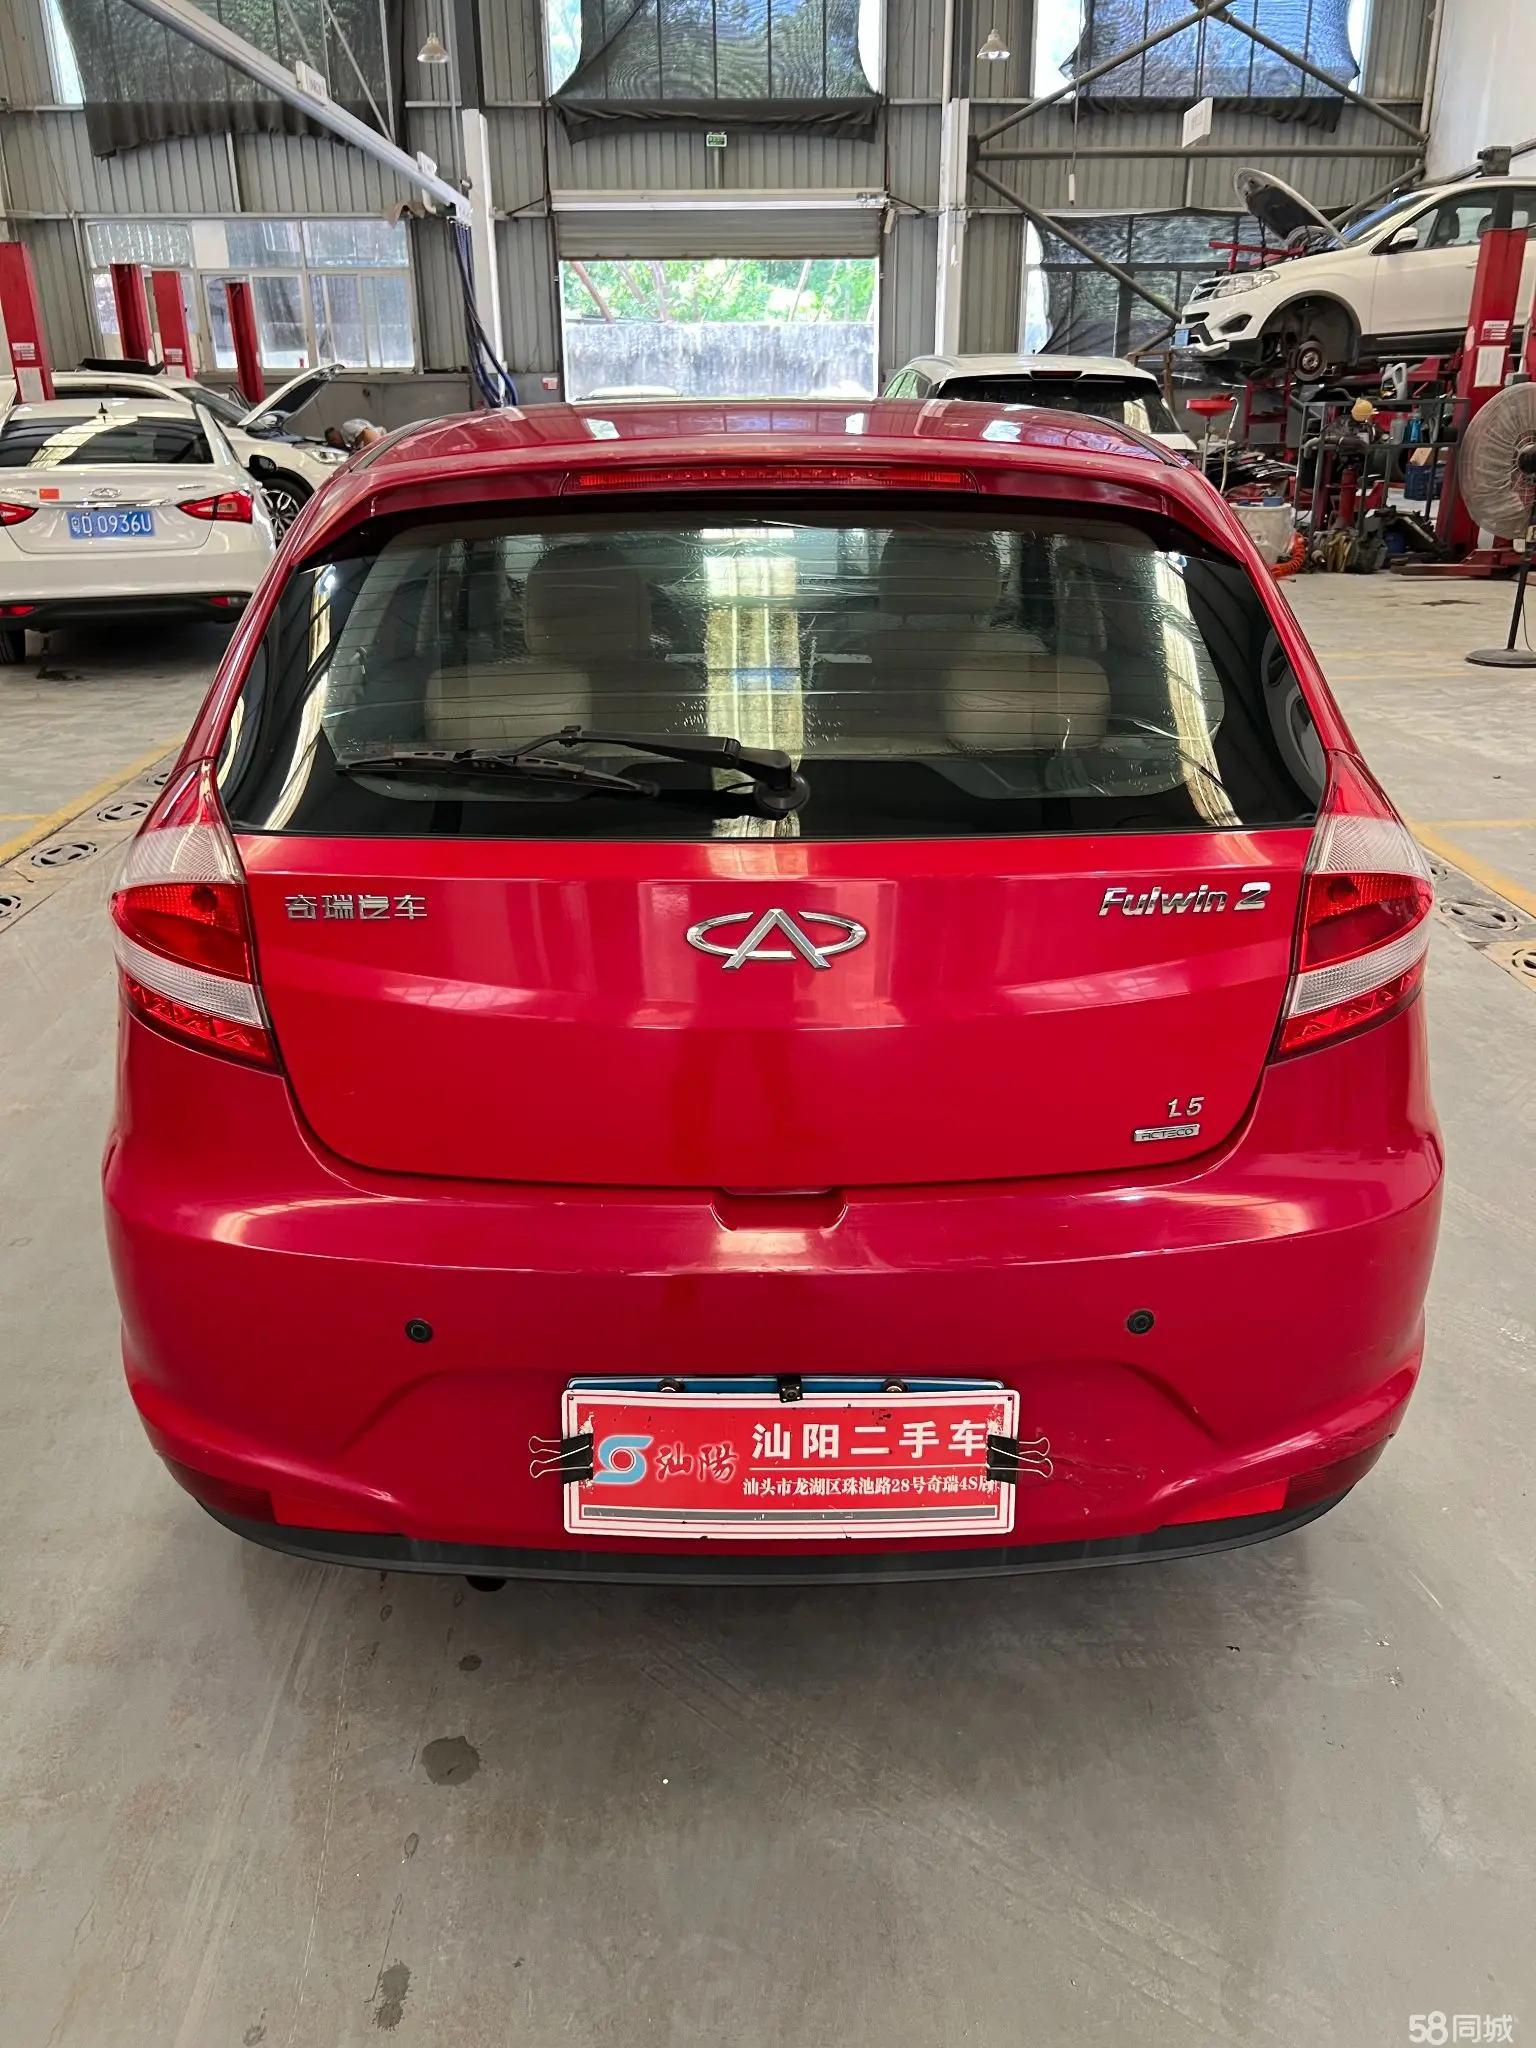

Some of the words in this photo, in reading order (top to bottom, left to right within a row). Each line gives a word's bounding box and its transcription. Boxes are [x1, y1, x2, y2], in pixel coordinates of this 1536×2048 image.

[285, 894, 428, 920] 奇瑞汽车
[1098, 884, 1228, 917] Fulwin
[1233, 881, 1271, 911] 2
[1141, 1127, 1194, 1140] ACTECO
[751, 1419, 987, 1460] 汕阳二手车
